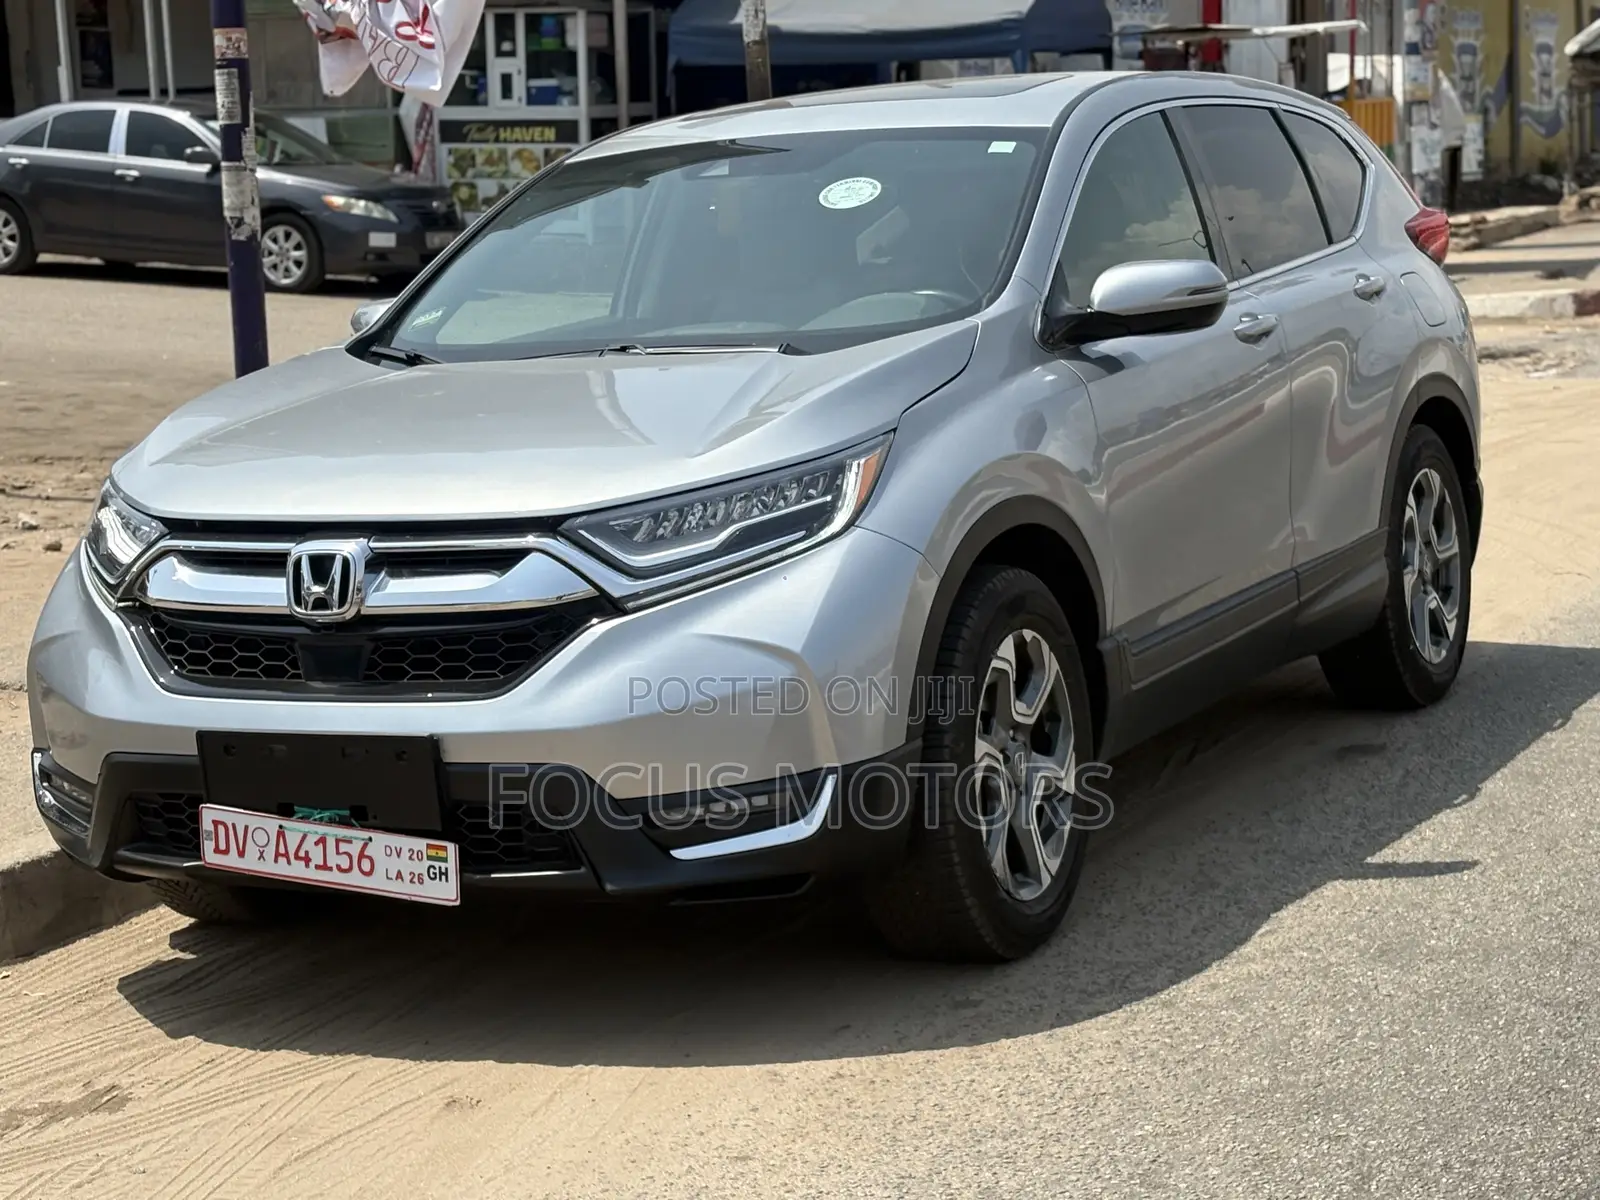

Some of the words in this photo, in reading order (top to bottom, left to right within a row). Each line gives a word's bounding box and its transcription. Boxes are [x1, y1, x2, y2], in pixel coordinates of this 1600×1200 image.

[498, 126, 556, 141] HAVEN
[211, 819, 249, 859] DV
[273, 828, 376, 878] A4156
[384, 845, 403, 859] DV
[408, 849, 424, 862] 20
[385, 868, 404, 882] LA
[408, 873, 425, 886] 26
[426, 864, 450, 884] GH
